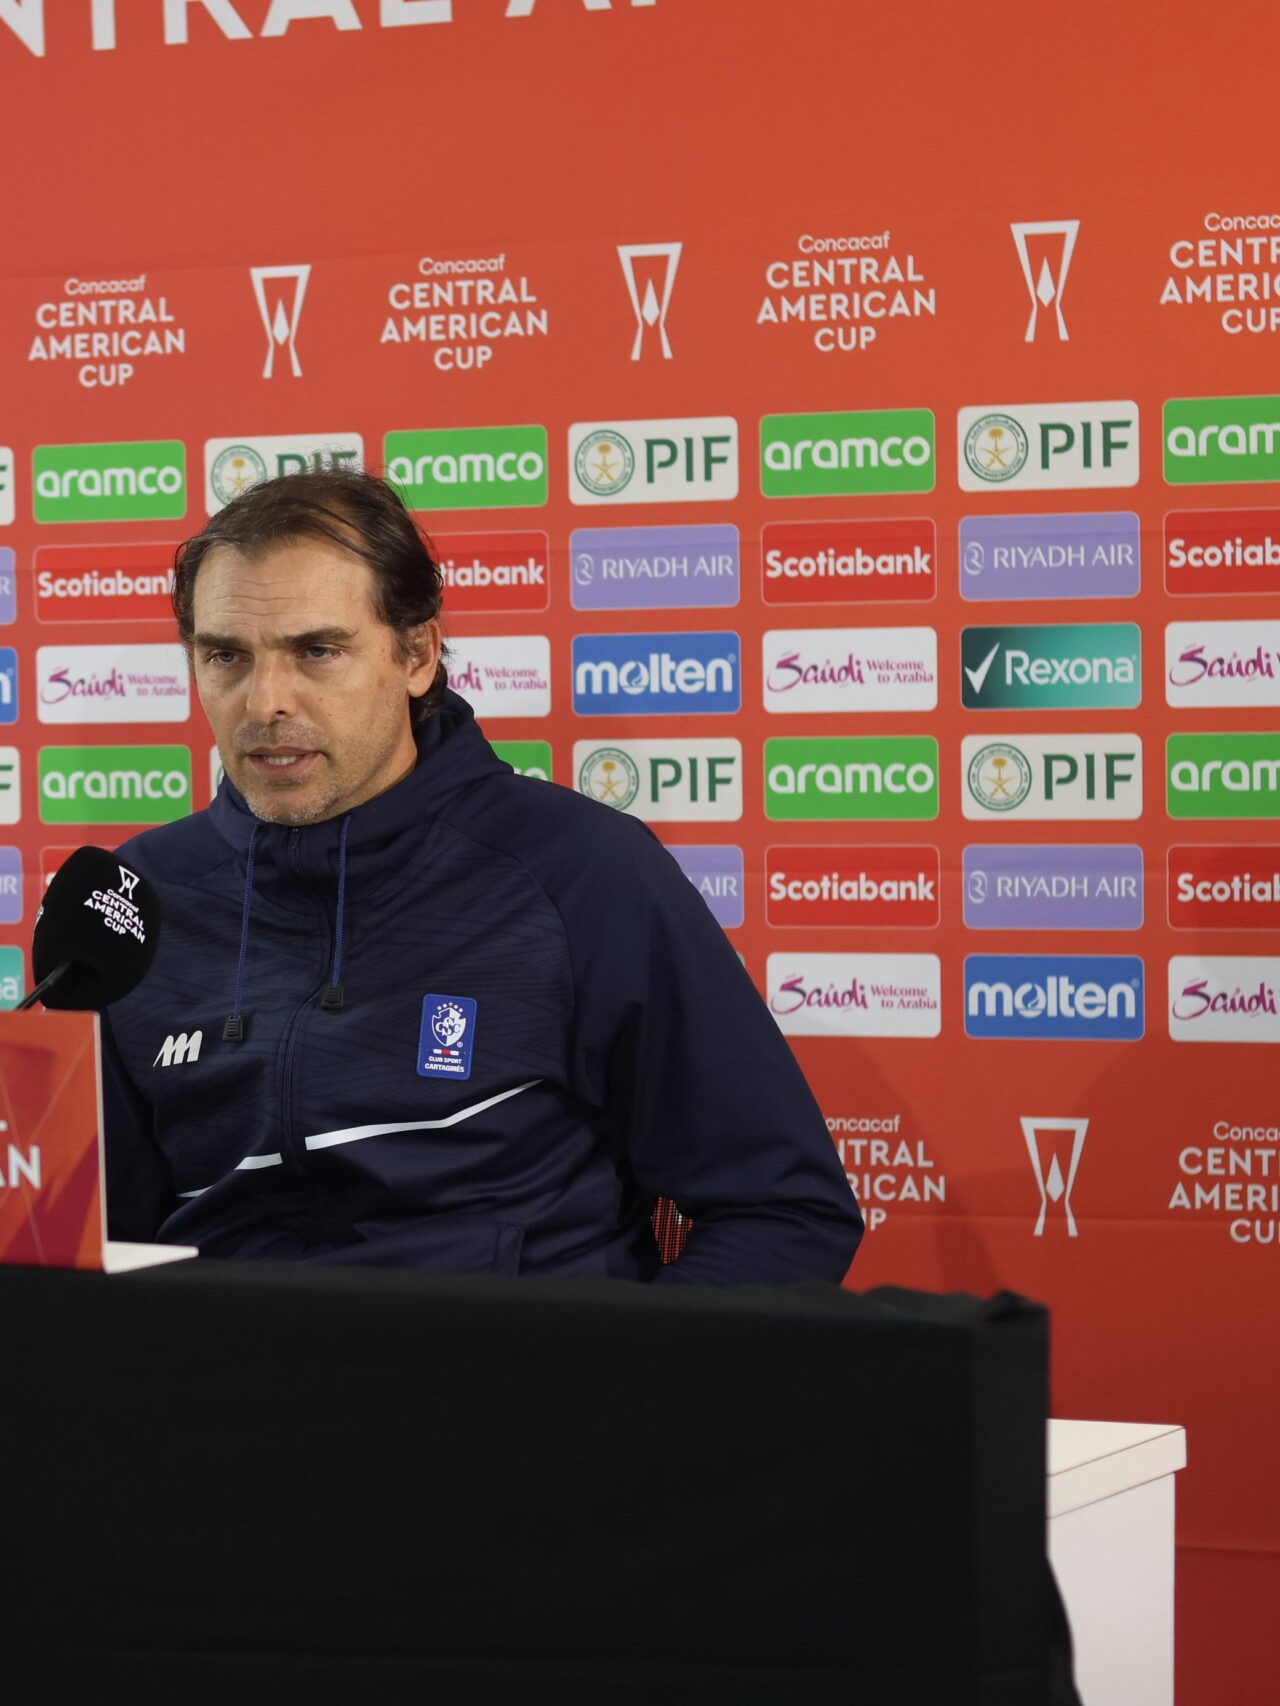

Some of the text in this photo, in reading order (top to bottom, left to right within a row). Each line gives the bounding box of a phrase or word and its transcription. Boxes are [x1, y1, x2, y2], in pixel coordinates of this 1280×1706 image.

[798, 231, 890, 253] Concacaf
[419, 254, 505, 275] Concacaf
[767, 255, 923, 288] CENTRAL
[64, 275, 145, 295] Concacaf
[389, 277, 536, 309] CENTRAL
[1160, 272, 1280, 304] AMERI
[36, 297, 174, 328] CENTRAL
[757, 289, 935, 323] AMERICAN
[381, 310, 547, 343] AMERICAN
[815, 326, 876, 351] CUP
[29, 328, 184, 360] AMERICAN
[434, 346, 492, 370] CUP
[79, 363, 133, 387] CUP
[645, 436, 731, 483] PIF
[765, 436, 930, 470] aramco
[1040, 421, 1131, 469] PIF
[36, 466, 182, 498] aramco
[389, 452, 543, 485] aramco
[603, 556, 733, 578] RIYADH AIR
[766, 546, 931, 577] Scotiabank
[994, 545, 1133, 568] RIYADH AIR
[484, 667, 538, 680] Welcome
[576, 654, 732, 694] molten
[766, 653, 922, 693] Saudi Welcome
[876, 670, 934, 683] to Arabia
[1006, 651, 1133, 684] Rexona
[1169, 645, 1275, 687] Saudi
[40, 668, 178, 704] Saudi Welcome
[136, 684, 188, 698] to Arabia
[494, 679, 547, 690] to Arabia
[42, 771, 187, 799] aramco
[650, 757, 735, 802] PIF
[768, 763, 934, 793] aramco
[1043, 754, 1135, 800] PIF
[700, 875, 738, 897] AIR
[770, 872, 934, 900] Scotiabank
[997, 877, 1136, 897] RIYADH AIR
[83, 898, 146, 944] AMERICAN
[92, 890, 144, 931] CENTRAL
[104, 917, 126, 935] CUP
[770, 976, 928, 1016] Saudi Welcome
[881, 995, 939, 1012] to Arabia
[969, 976, 1135, 1018] molten
[1172, 981, 1278, 1020] Saudi
[1213, 1122, 1280, 1141] Conca
[1179, 1147, 1276, 1176] CENT
[1230, 1219, 1280, 1243] CU
